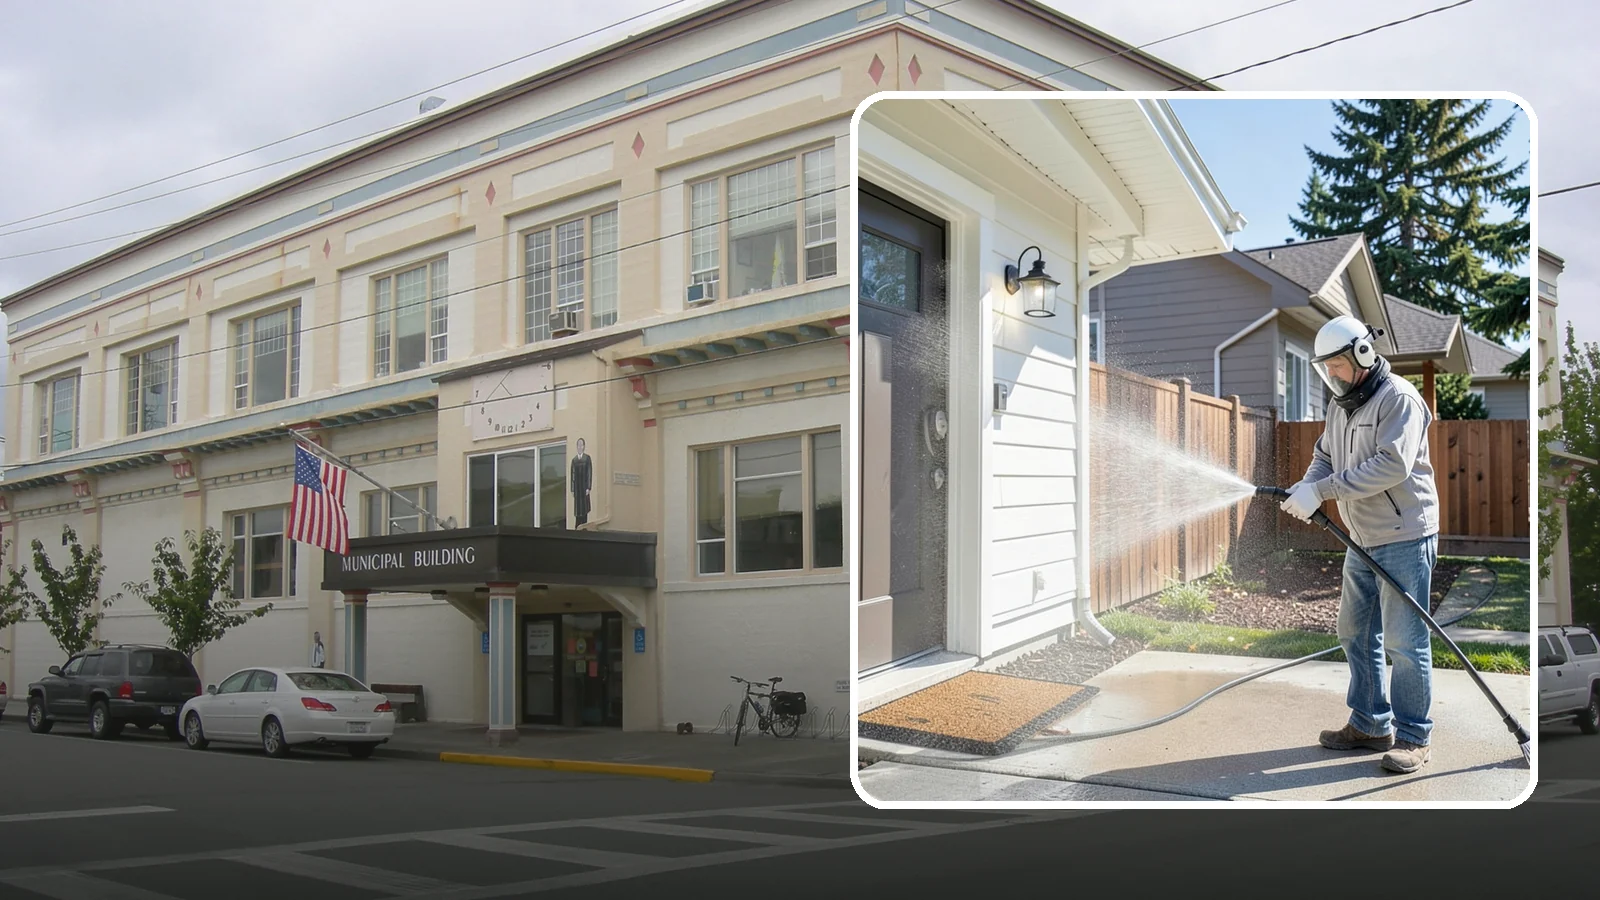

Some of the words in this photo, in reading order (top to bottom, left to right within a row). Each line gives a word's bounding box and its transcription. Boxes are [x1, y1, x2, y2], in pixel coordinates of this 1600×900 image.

[536, 402, 540, 410] 4
[480, 406, 485, 415] 8
[488, 418, 492, 426] 9
[528, 414, 533, 422] 3
[494, 424, 500, 432] 10
[521, 420, 526, 428] 2
[502, 426, 506, 434] 11
[508, 425, 513, 433] 12
[342, 552, 405, 572] MUNICIPAL
[414, 546, 475, 567] BUILDING
